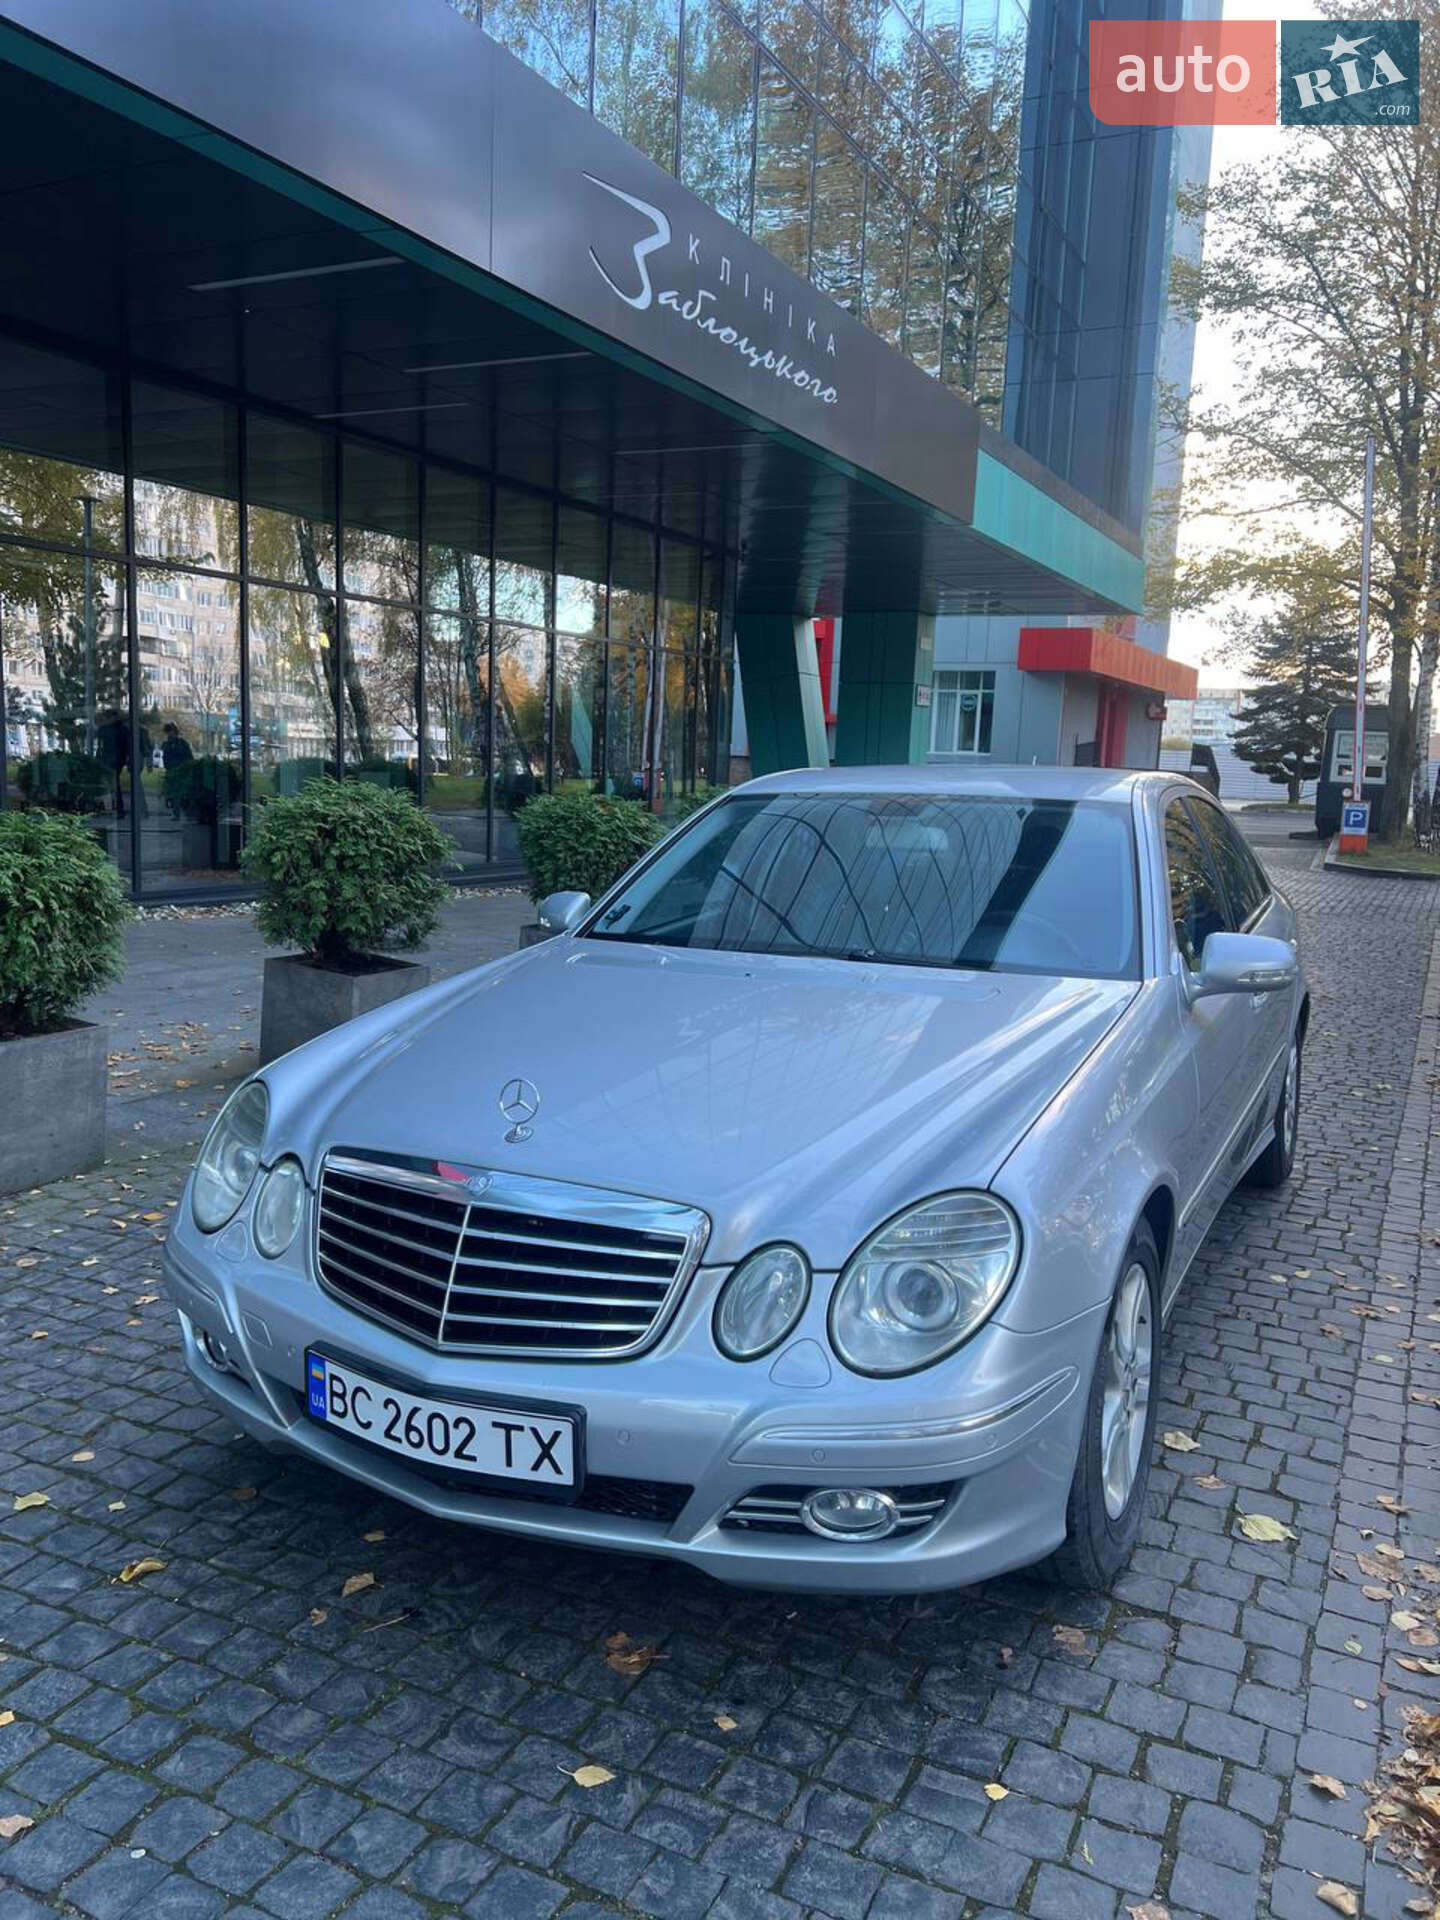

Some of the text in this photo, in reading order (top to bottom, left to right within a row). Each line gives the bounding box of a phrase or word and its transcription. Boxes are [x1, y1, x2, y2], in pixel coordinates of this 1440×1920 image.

[688, 233, 836, 357] КЛІНІКА
[1350, 811, 1364, 826] P
[311, 1392, 325, 1409] UA
[329, 1373, 564, 1475] BC 2602 TX
